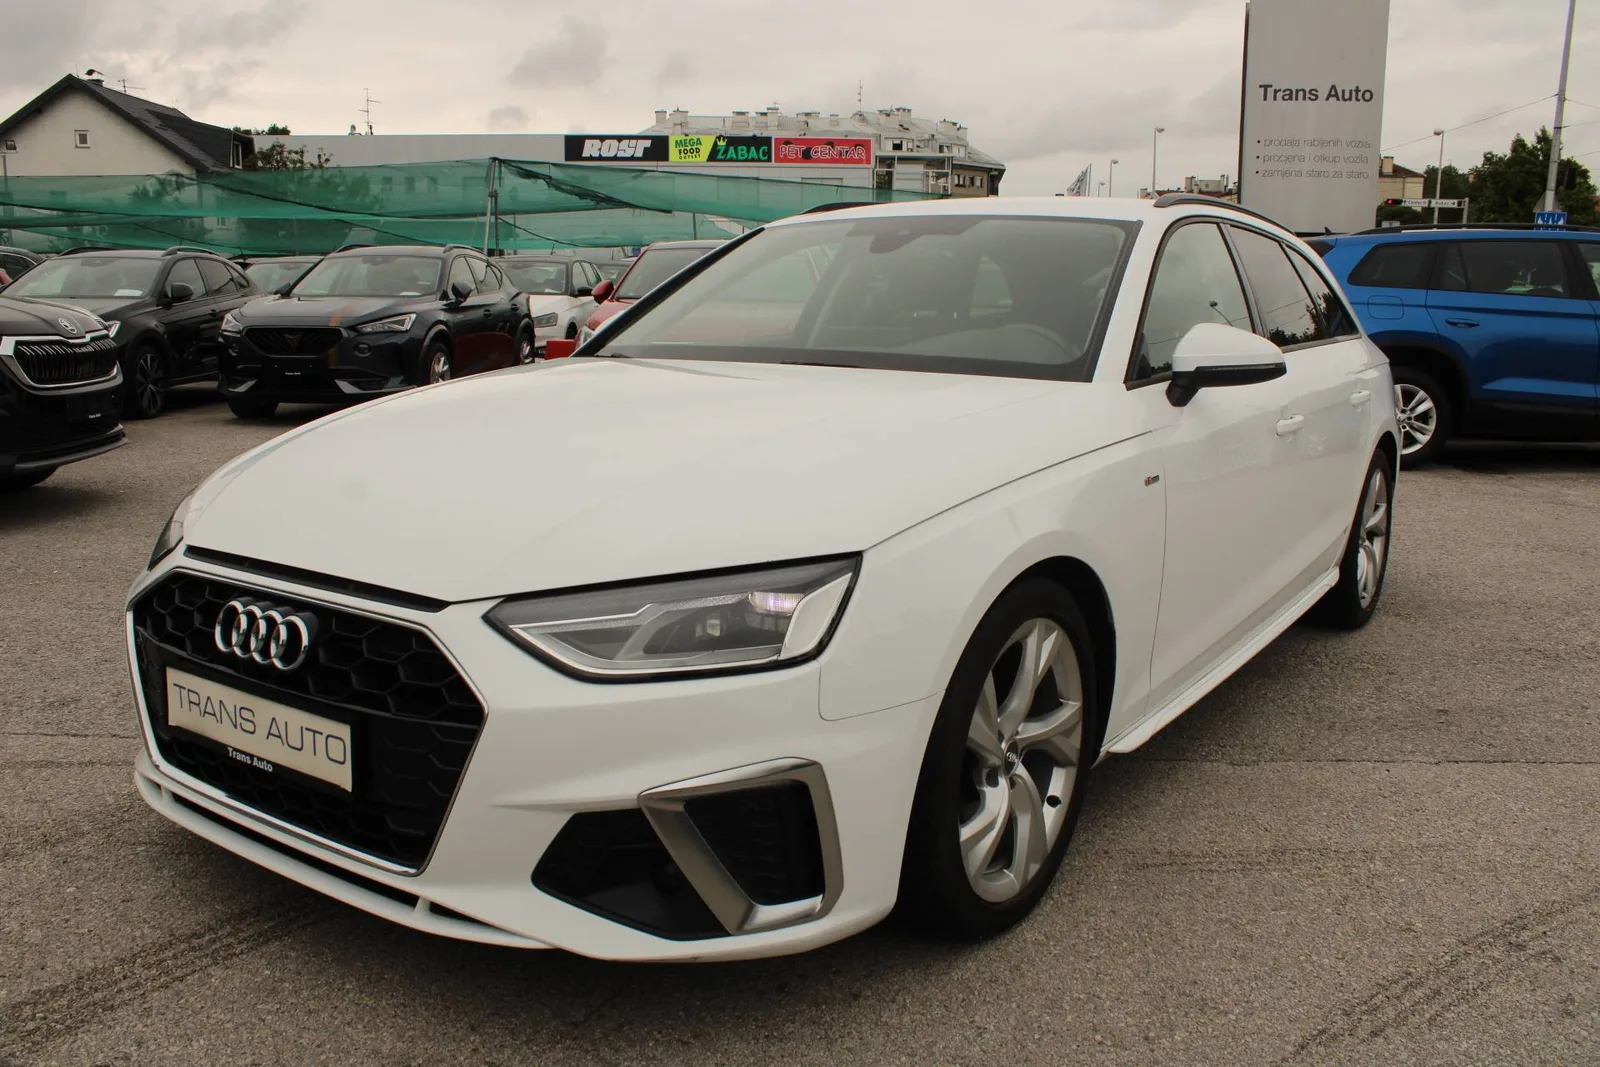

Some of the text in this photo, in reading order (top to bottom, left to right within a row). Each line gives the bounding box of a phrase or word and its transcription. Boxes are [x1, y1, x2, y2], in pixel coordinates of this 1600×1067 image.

[1258, 84, 1374, 103] Trans Auto
[582, 139, 652, 158] ROST
[675, 138, 702, 148] MEGA
[678, 147, 701, 155] FOOD
[1263, 138, 1300, 149] prodaja
[780, 144, 866, 160] PET CENTAR
[1261, 168, 1369, 179] zamjena staro za staro
[173, 683, 347, 765] TRANS AUTO
[227, 747, 273, 773] Trans Auto
